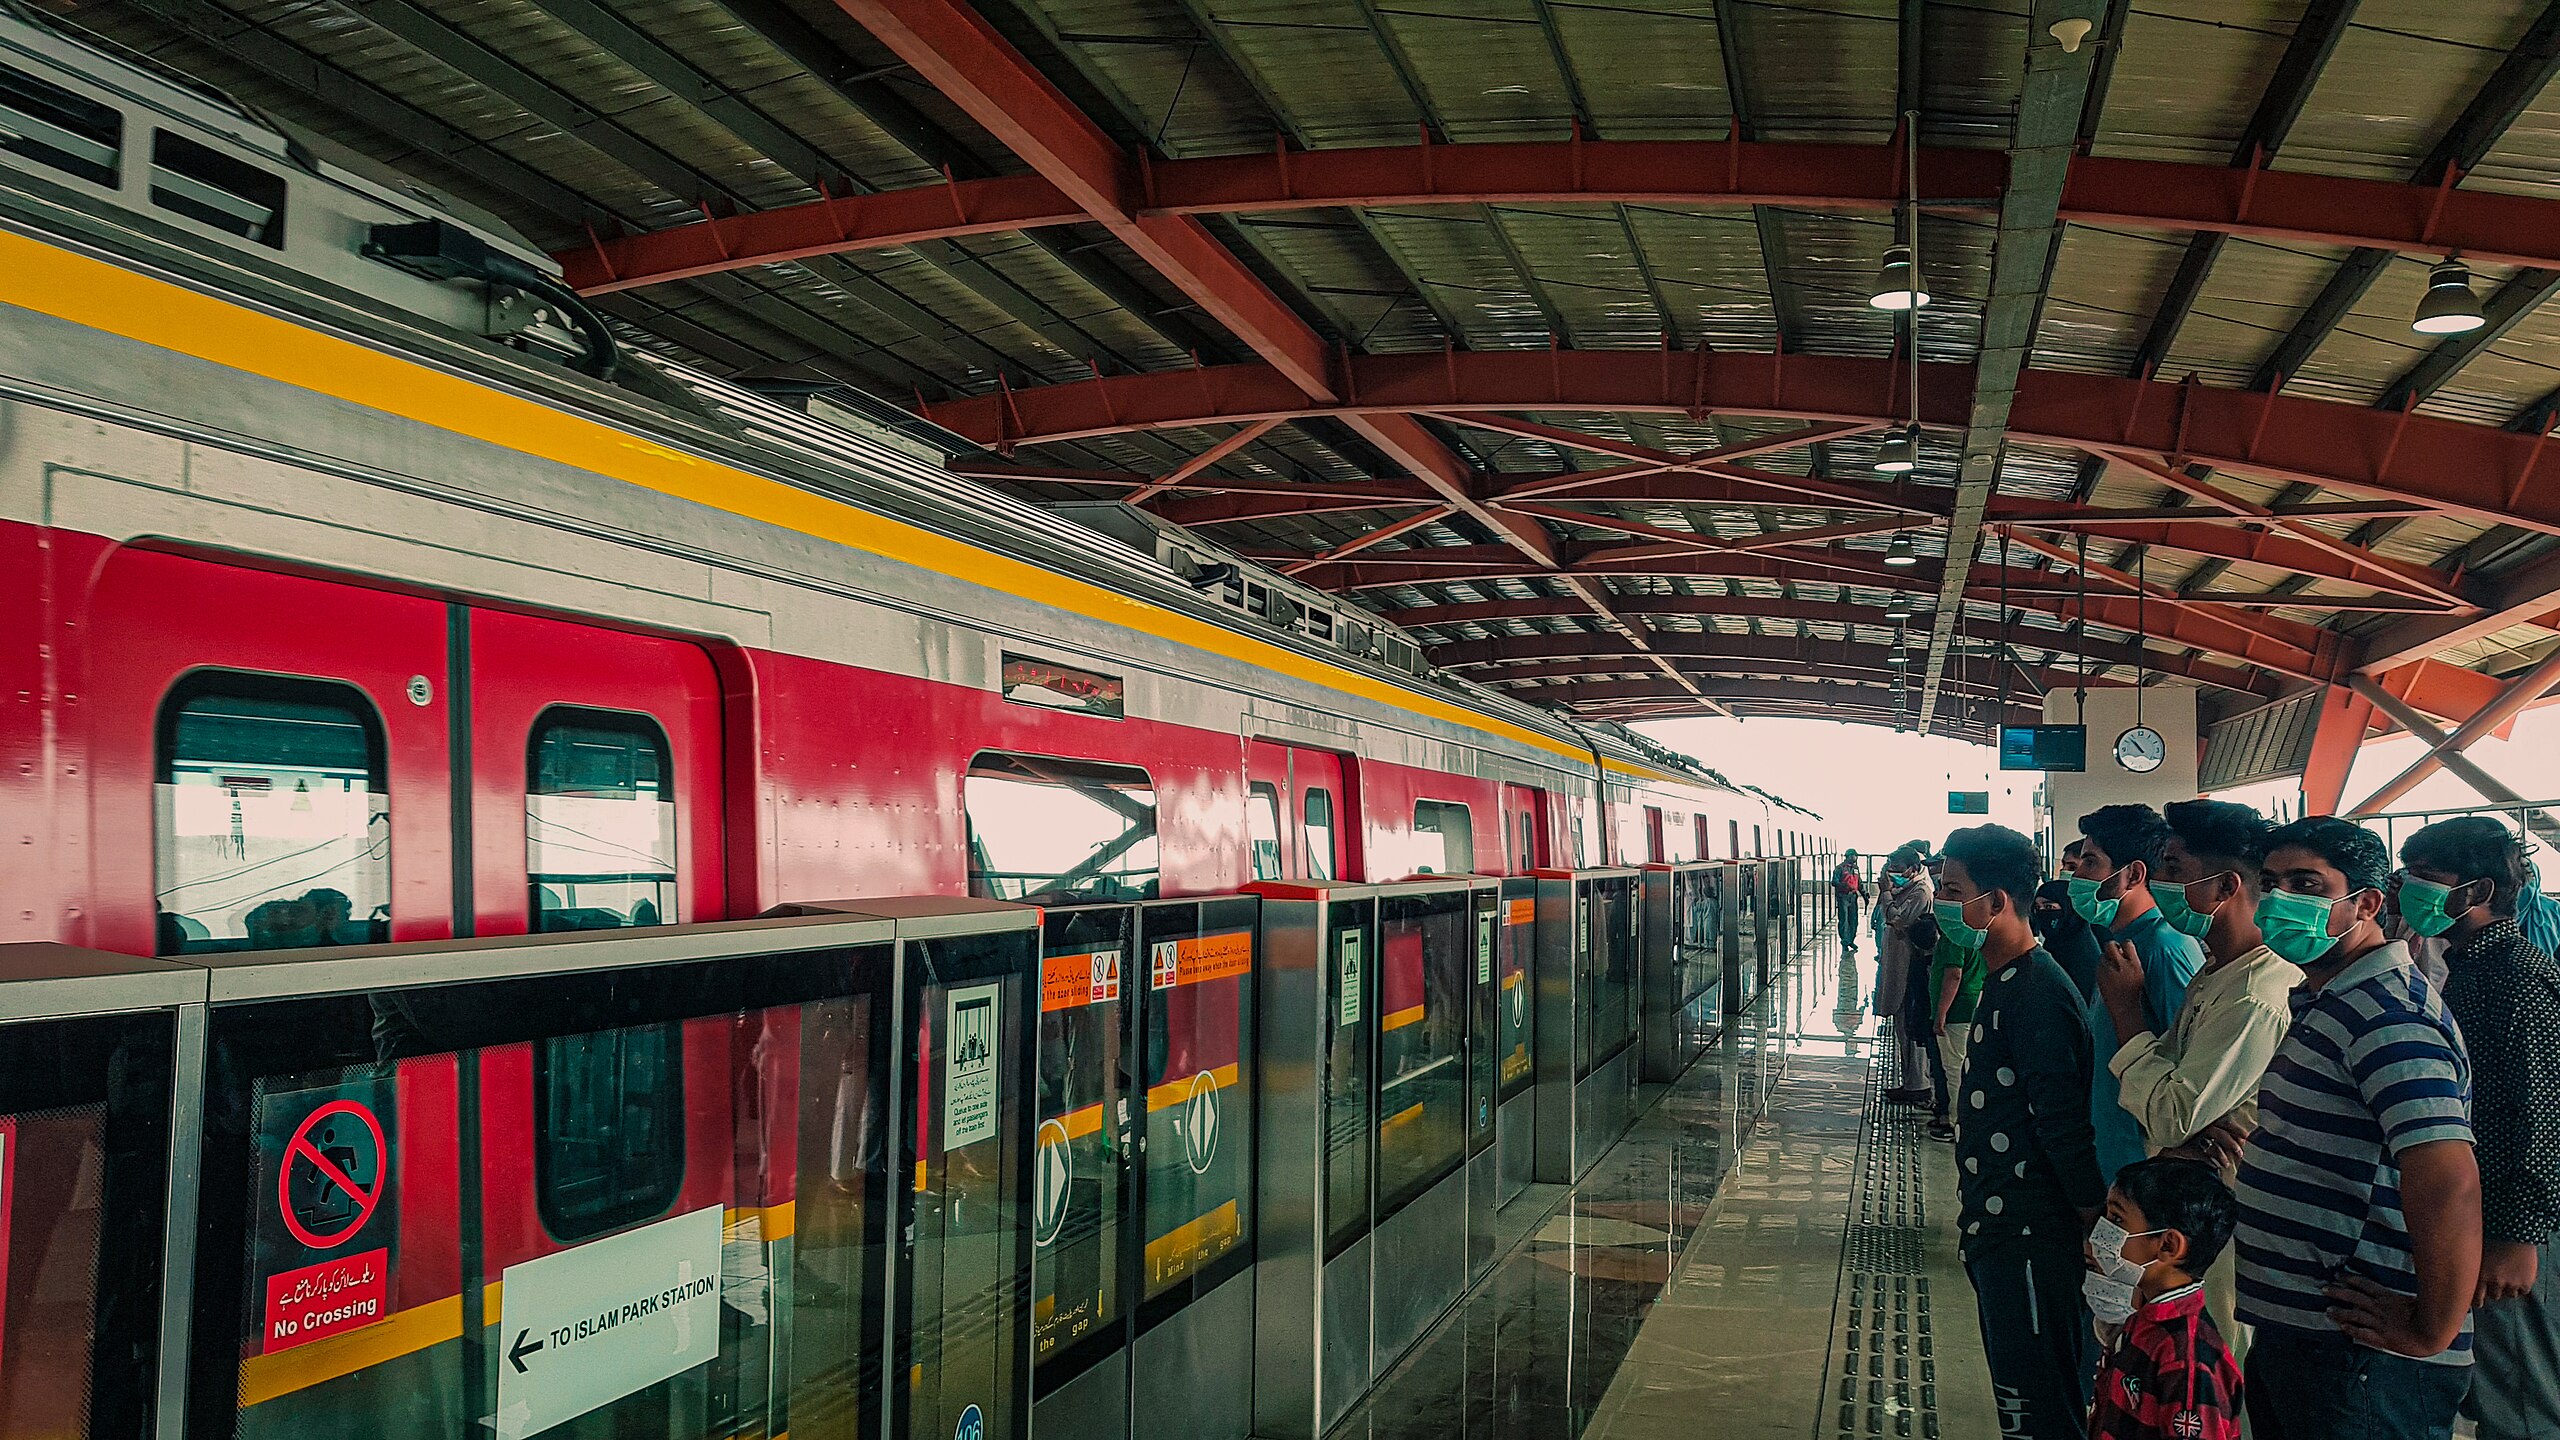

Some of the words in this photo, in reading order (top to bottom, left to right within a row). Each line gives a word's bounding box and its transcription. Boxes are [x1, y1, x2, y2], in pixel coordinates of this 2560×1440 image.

[1168, 1260, 1184, 1277] Mind
[1198, 1248, 1209, 1260] the
[1220, 1236, 1231, 1250] gap
[274, 1319, 298, 1339] No
[303, 1298, 377, 1330] Crossing
[550, 1326, 571, 1350] TO
[574, 1308, 619, 1342] ISLAM
[622, 1293, 659, 1324] PARK
[661, 1274, 715, 1309] STATION
[1040, 1337, 1055, 1352] the
[1072, 1318, 1088, 1337] gap
